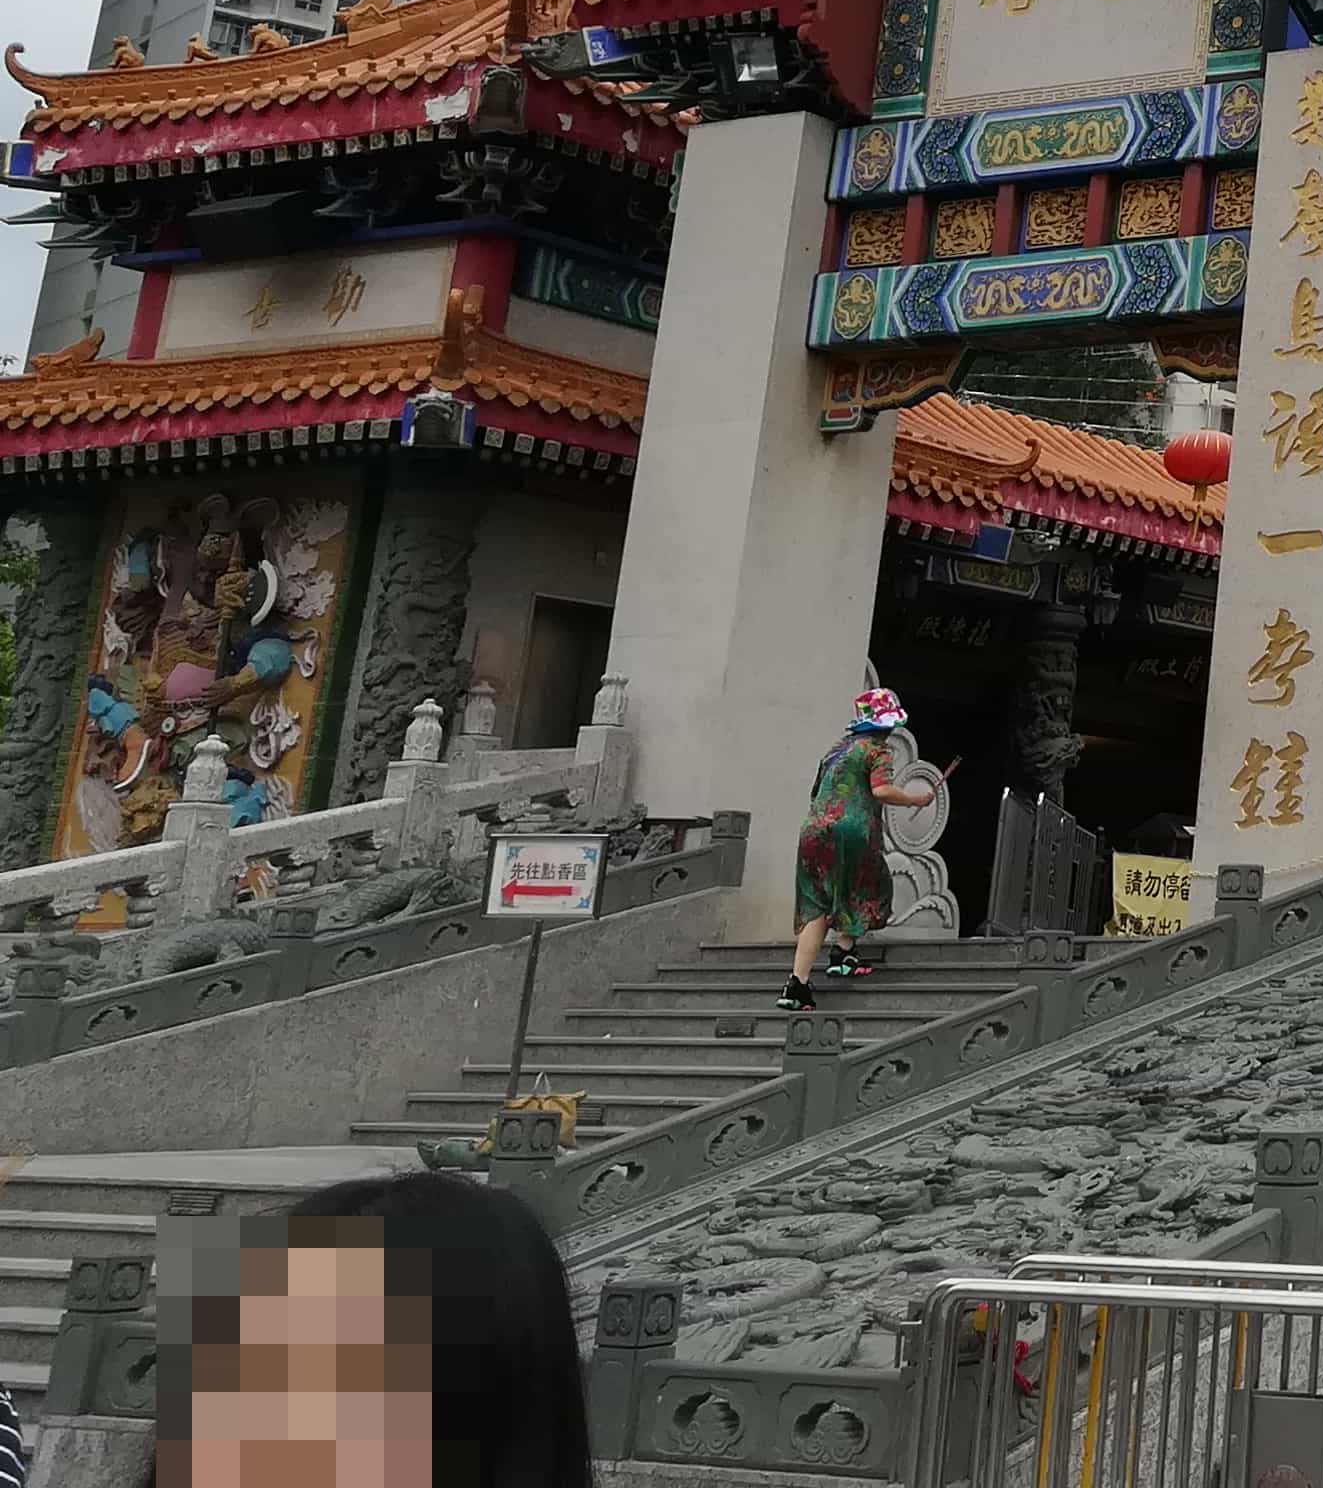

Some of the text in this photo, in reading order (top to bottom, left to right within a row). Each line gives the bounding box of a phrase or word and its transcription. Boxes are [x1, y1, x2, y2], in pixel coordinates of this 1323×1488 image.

[510, 862, 588, 881] 先往點香區
